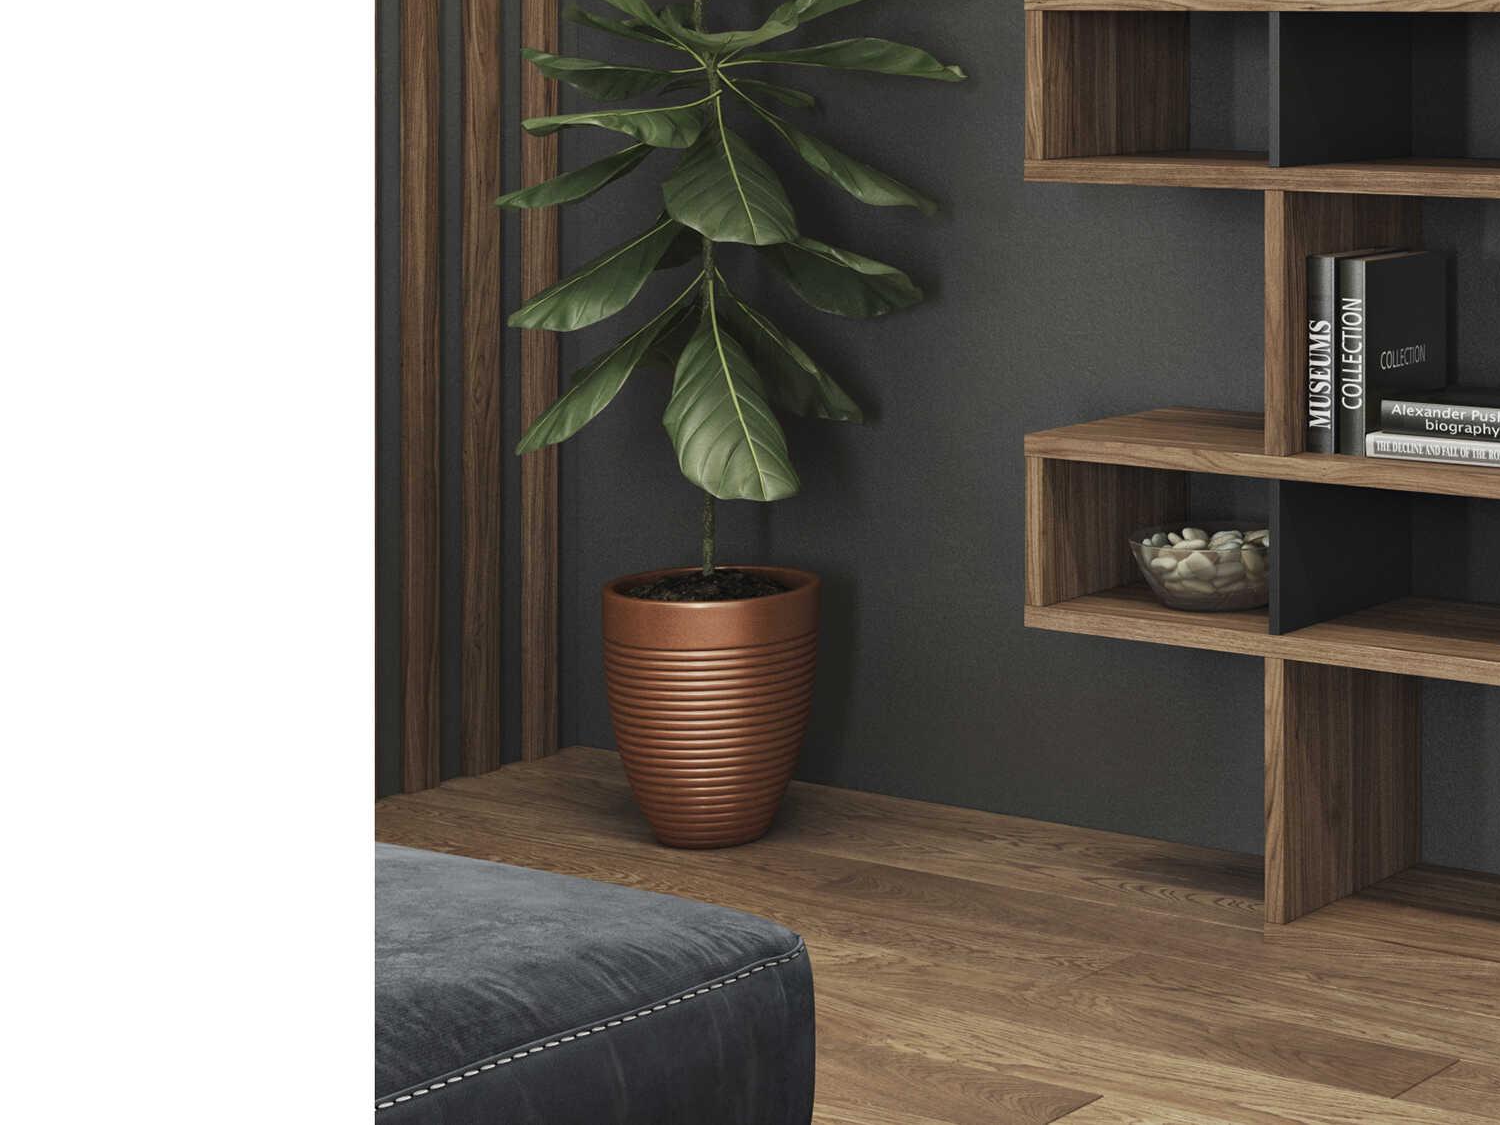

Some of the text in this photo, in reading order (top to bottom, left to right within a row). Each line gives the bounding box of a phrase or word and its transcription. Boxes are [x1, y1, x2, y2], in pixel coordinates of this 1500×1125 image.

[1342, 298, 1362, 409] COLLECTION
[1380, 344, 1427, 370] COLLECTION
[1309, 320, 1331, 429] MUSEUMS
[1391, 403, 1466, 420] Alexander
[1425, 419, 1500, 437] biography
[1376, 440, 1392, 452] THE
[1392, 442, 1424, 454] DECLINE
[1425, 444, 1441, 456] AND
[1442, 445, 1459, 457] FALL
[1460, 447, 1470, 458] OF
[1472, 448, 1487, 460] THE
